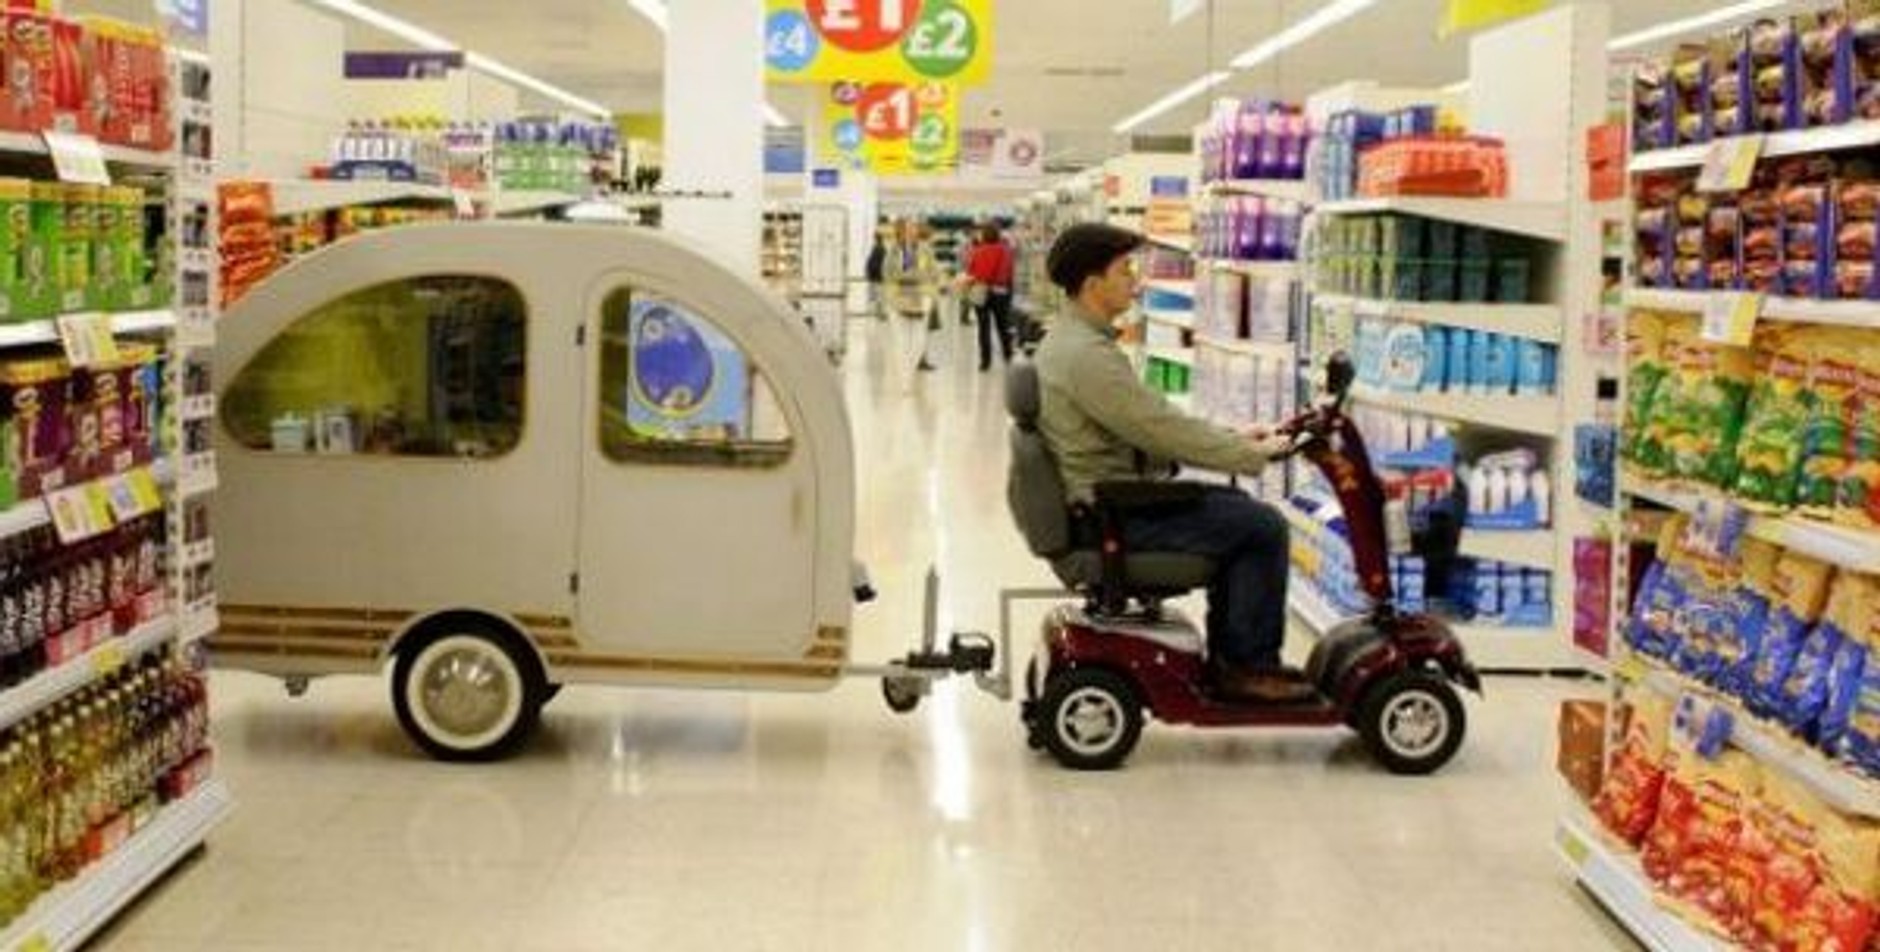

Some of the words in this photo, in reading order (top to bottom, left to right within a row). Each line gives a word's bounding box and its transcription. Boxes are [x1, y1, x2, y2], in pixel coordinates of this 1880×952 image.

[766, 21, 807, 57] £4
[906, 8, 969, 59] £2
[864, 86, 909, 131] £1
